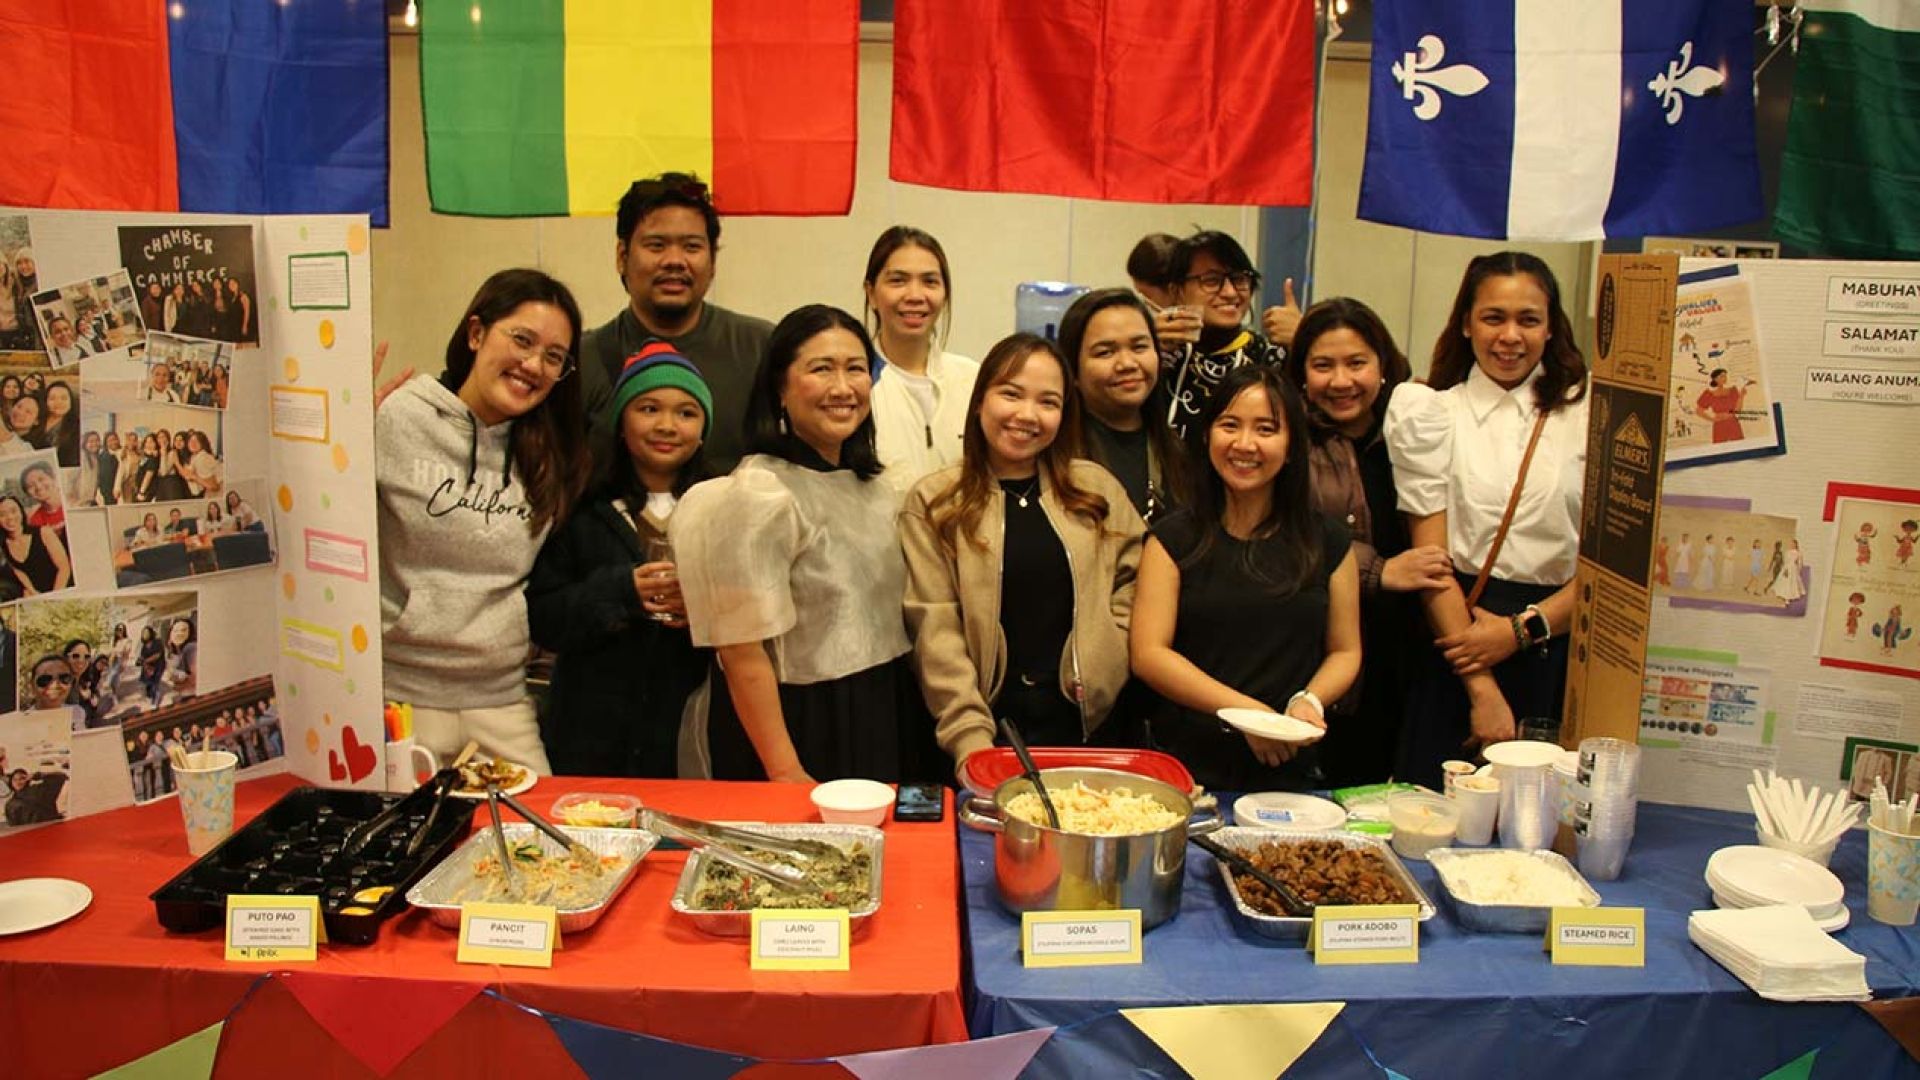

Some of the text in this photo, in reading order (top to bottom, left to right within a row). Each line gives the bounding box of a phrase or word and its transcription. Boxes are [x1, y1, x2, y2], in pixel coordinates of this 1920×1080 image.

[143, 229, 214, 261] CHAMBER
[172, 255, 191, 270] OF
[1840, 327, 1919, 342] SALAMAT
[1811, 372, 1920, 388] WALANG ANUM
[426, 477, 532, 525] Californ
[248, 912, 295, 921] PUTO PAO
[490, 922, 526, 933] PANCIT
[785, 924, 815, 933] LAING
[1066, 925, 1098, 935] SOPAS
[1338, 921, 1398, 932] PORK ADOBO
[1564, 929, 1631, 939] STEAMED RICE
